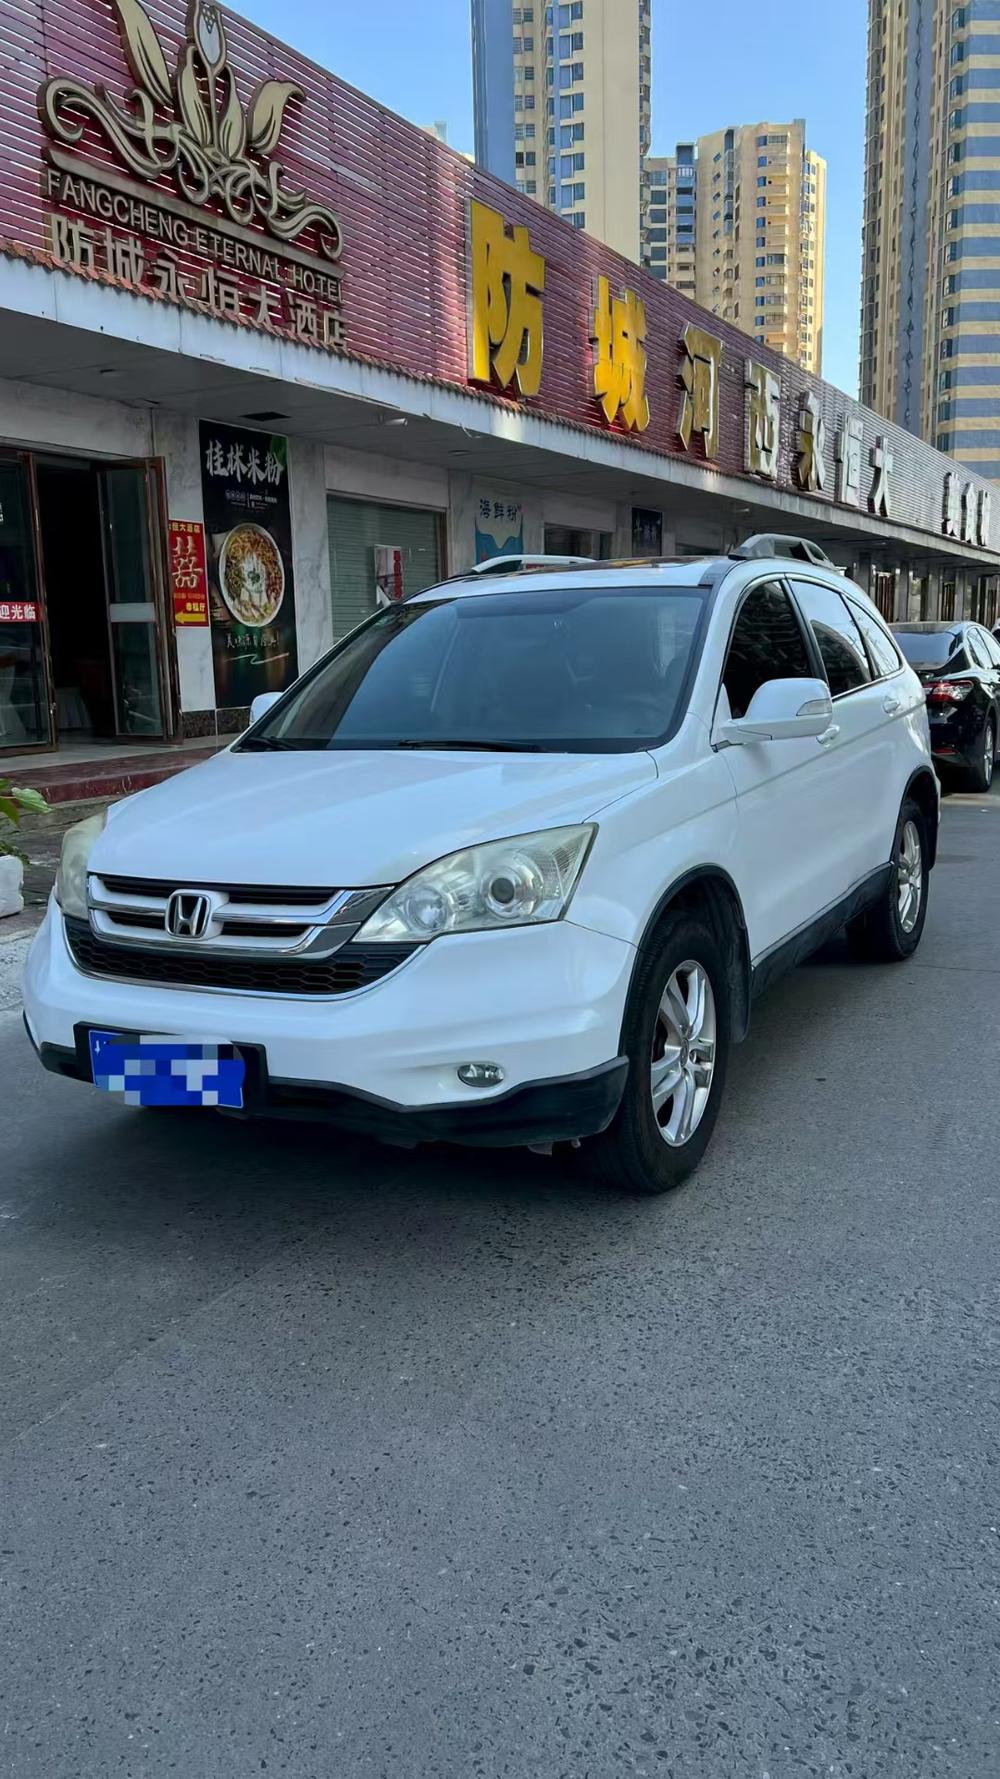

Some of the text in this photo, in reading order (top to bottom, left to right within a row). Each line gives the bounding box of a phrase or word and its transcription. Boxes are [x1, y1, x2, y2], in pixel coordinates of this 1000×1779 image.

[47, 168, 345, 304] FANGCHENG ETERNAL HOTEL
[50, 213, 348, 348] 防城永恒大酒店
[206, 440, 285, 486] 桂林米粉
